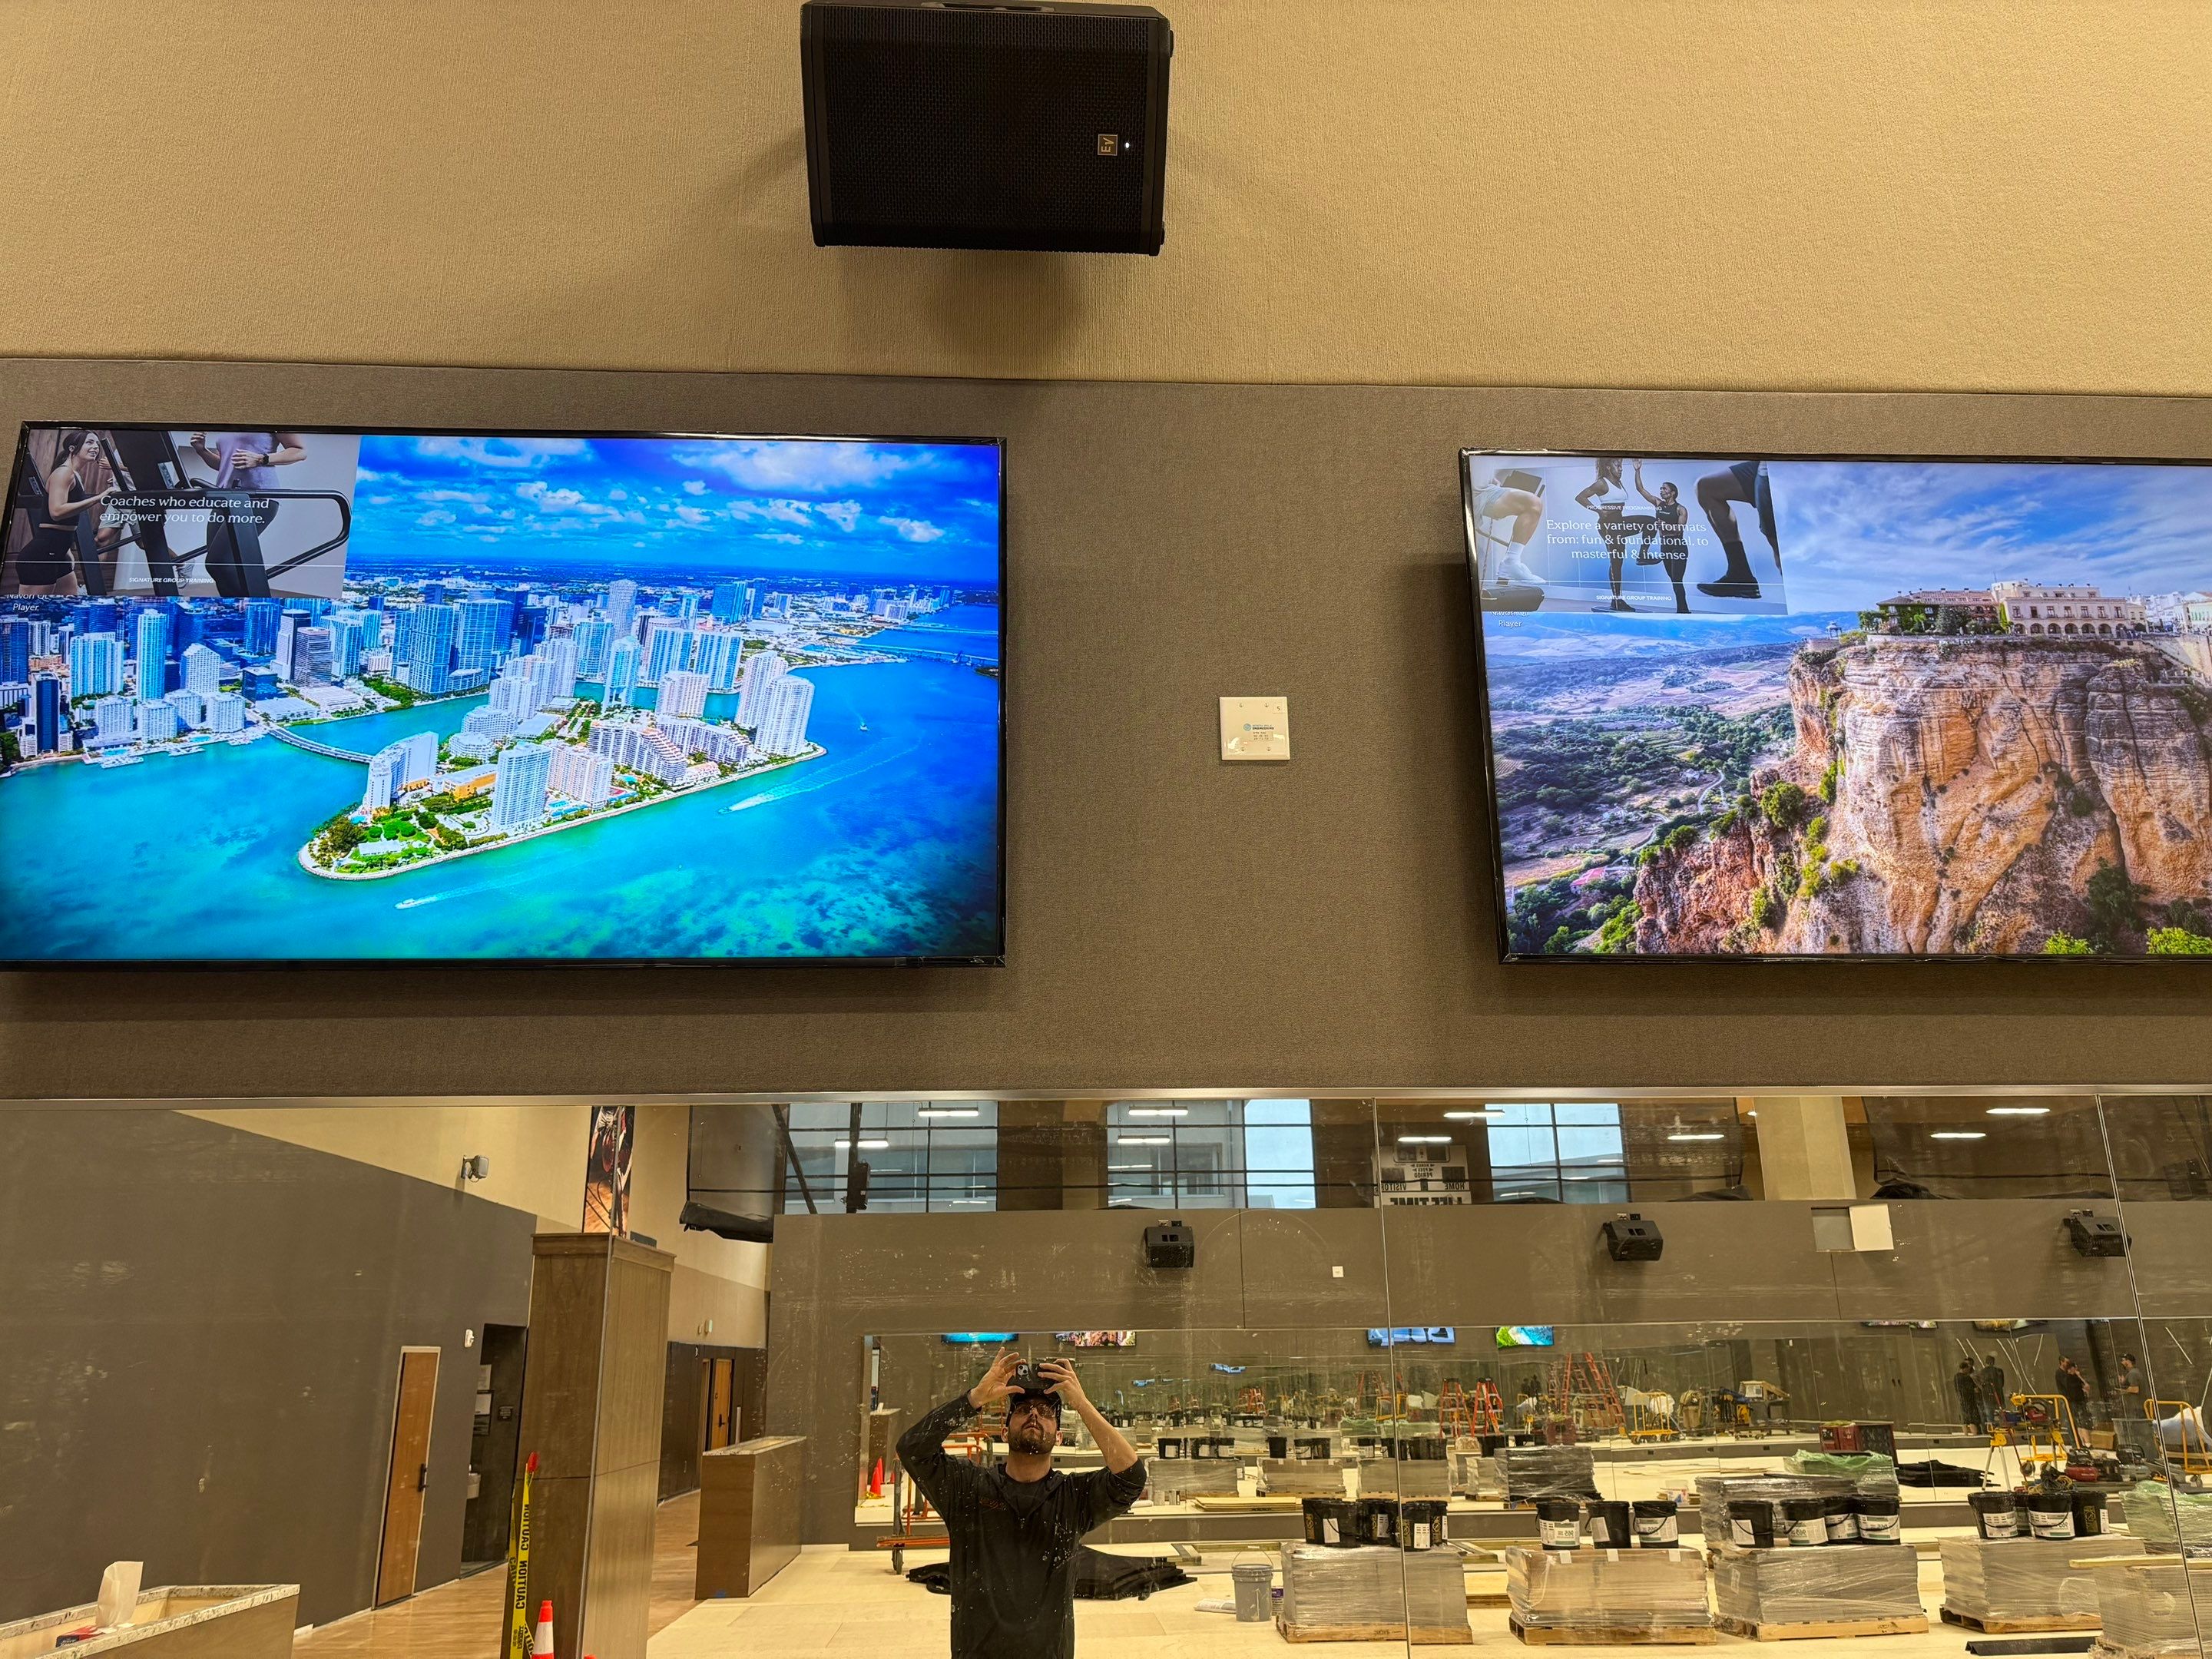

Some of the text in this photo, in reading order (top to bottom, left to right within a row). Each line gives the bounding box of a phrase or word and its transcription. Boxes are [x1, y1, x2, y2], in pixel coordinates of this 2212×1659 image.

[1101, 137, 1114, 153] EV
[101, 495, 269, 508] Coaches who educate and
[100, 512, 265, 525] empower you to do more.
[1546, 519, 1591, 533] Explore
[1604, 520, 1644, 533] variety
[1647, 521, 1659, 531] of
[1661, 521, 1707, 531] formats
[1547, 534, 1579, 545] from:
[1581, 534, 1602, 545] fun
[1605, 535, 1614, 545] &
[1697, 538, 1709, 546] to
[1571, 548, 1688, 560] masterful & intense.
[1498, 619, 1522, 628] Player
